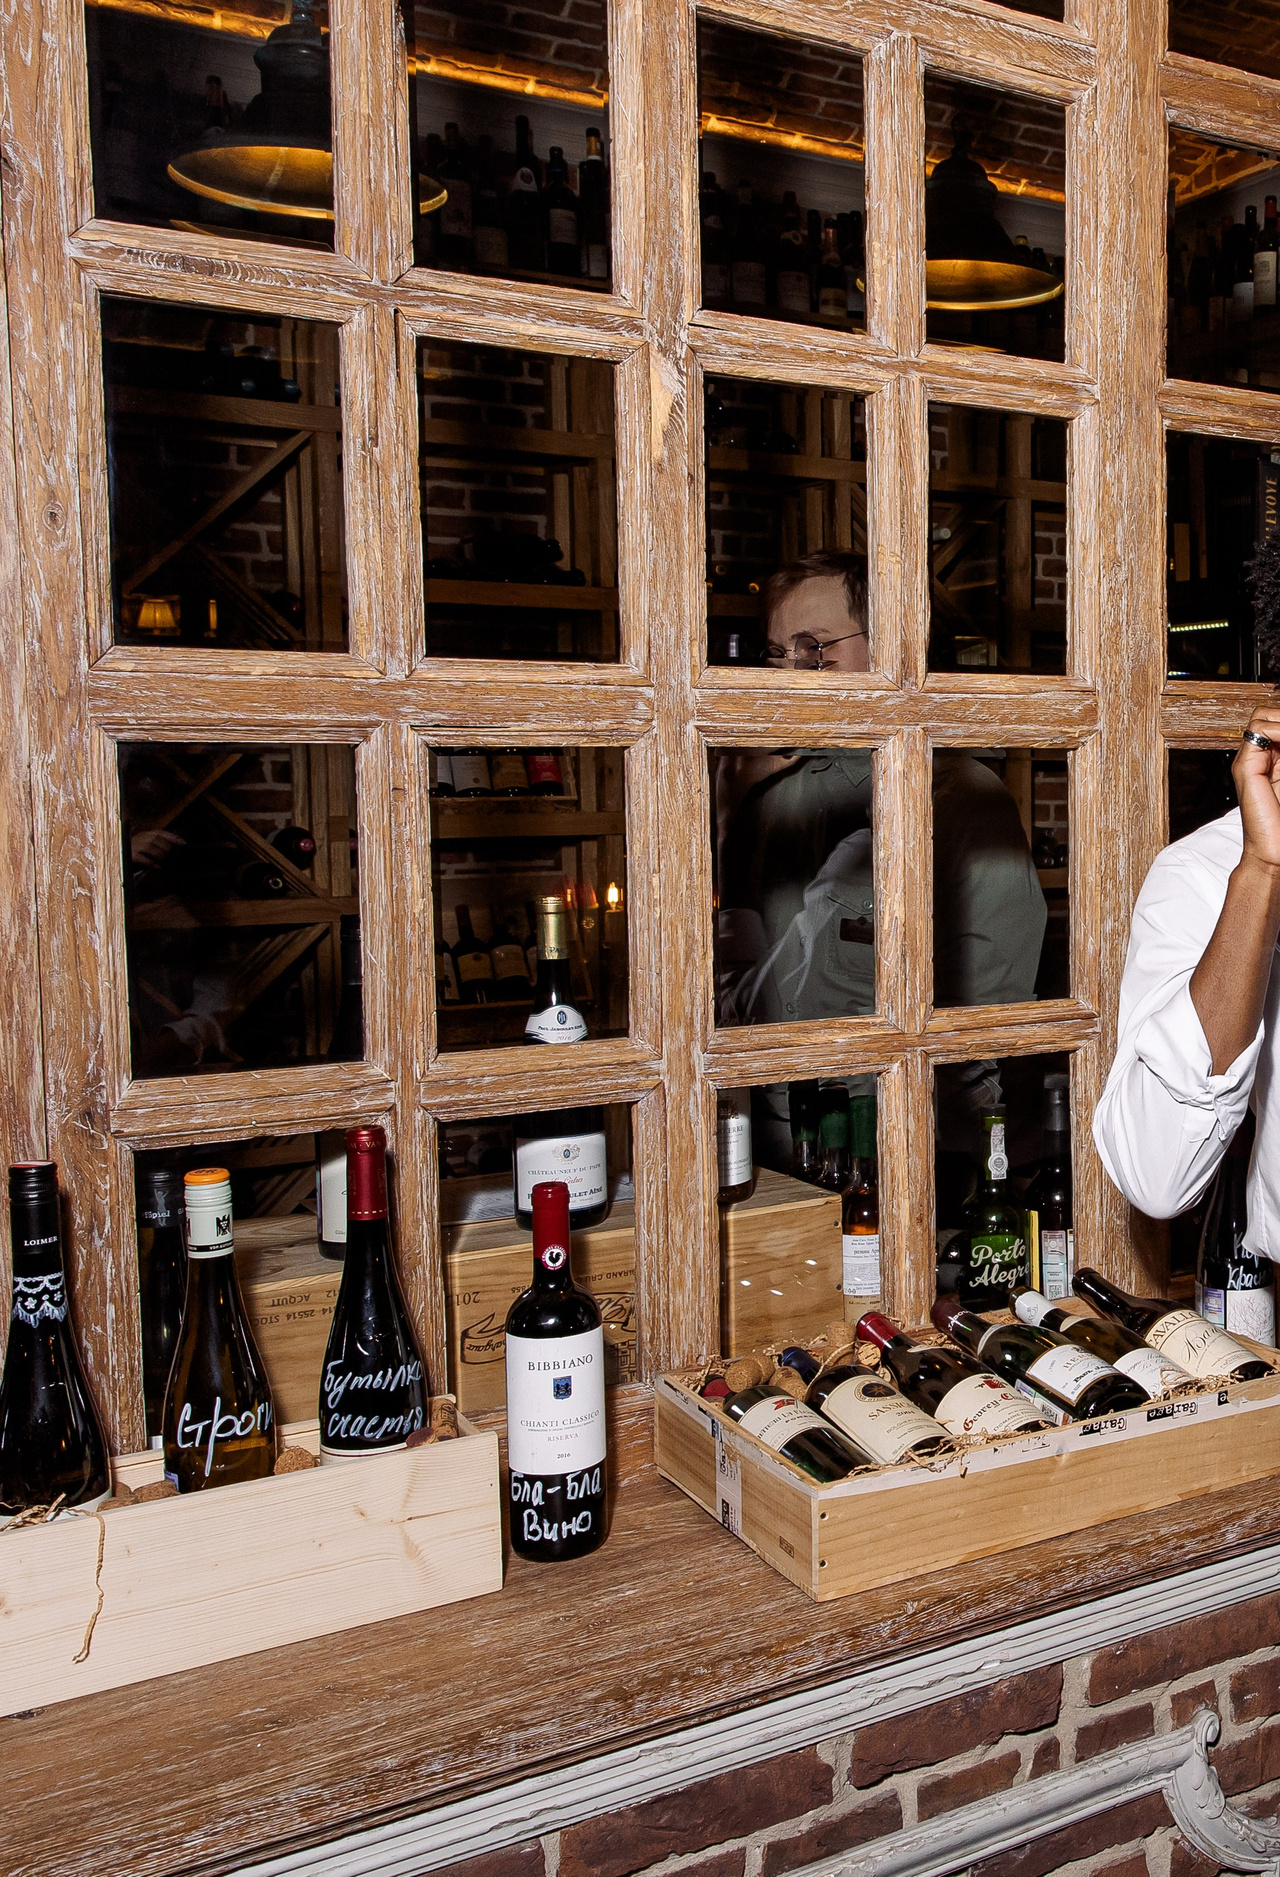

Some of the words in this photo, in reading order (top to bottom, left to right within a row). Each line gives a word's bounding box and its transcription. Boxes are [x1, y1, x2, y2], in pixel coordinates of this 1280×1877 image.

[24, 1235, 58, 1247] LOIMER
[970, 1238, 1027, 1268] Porto
[969, 1262, 1030, 1289] Alegre
[511, 1285, 529, 1294] 855
[270, 1293, 311, 1308] ACQUIT
[286, 1309, 315, 1321] 25514
[466, 1339, 506, 1352] argaux
[528, 1353, 593, 1371] BIBBIANO
[520, 1419, 559, 1428] CHIANTI
[562, 1409, 600, 1426] CLASSICO
[1148, 1401, 1197, 1419] Garage
[1080, 1417, 1126, 1435] Garag
[547, 1432, 579, 1442] RISERVA
[523, 1508, 592, 1542] Вино
